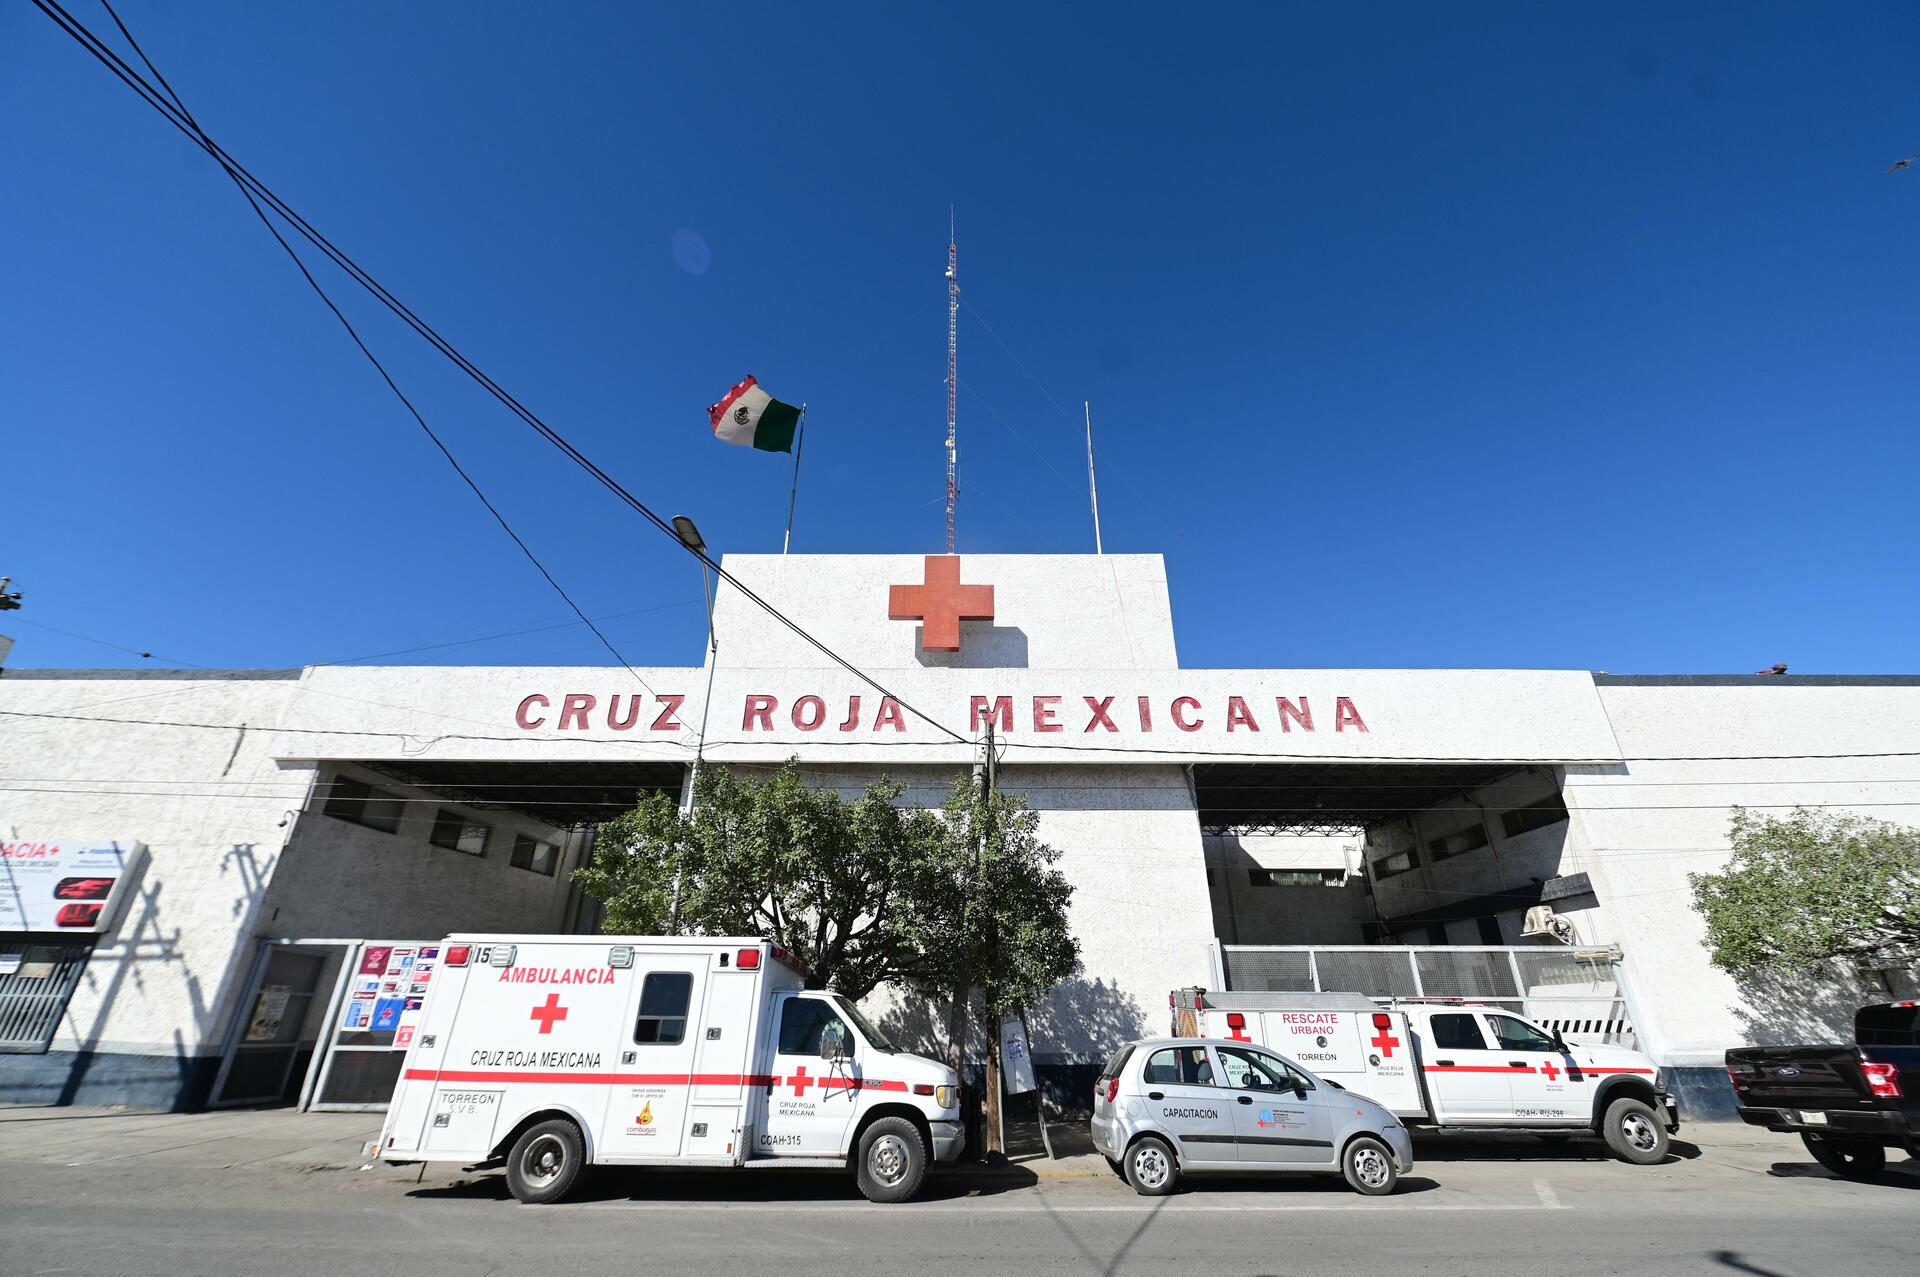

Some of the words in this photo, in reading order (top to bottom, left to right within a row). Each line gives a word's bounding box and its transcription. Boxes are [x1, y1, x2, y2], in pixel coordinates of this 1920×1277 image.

[515, 694, 686, 731] CRUZ
[742, 694, 907, 733] ROJA
[969, 694, 1370, 734] MEXICANA
[0, 842, 48, 858] ACIA
[498, 966, 615, 985] AMBULANCIA
[1282, 1013, 1338, 1024] RESCATE
[1291, 1026, 1334, 1035] URBANO
[470, 1050, 504, 1067] CRUZ
[505, 1051, 537, 1067] ROJA
[539, 1052, 601, 1068] MEXICANA
[1296, 1052, 1337, 1061] TORREÓN
[442, 1093, 495, 1105] TORREON
[1163, 1107, 1218, 1119] CAPACITACIÓN
[760, 1134, 801, 1146] COAH-315
